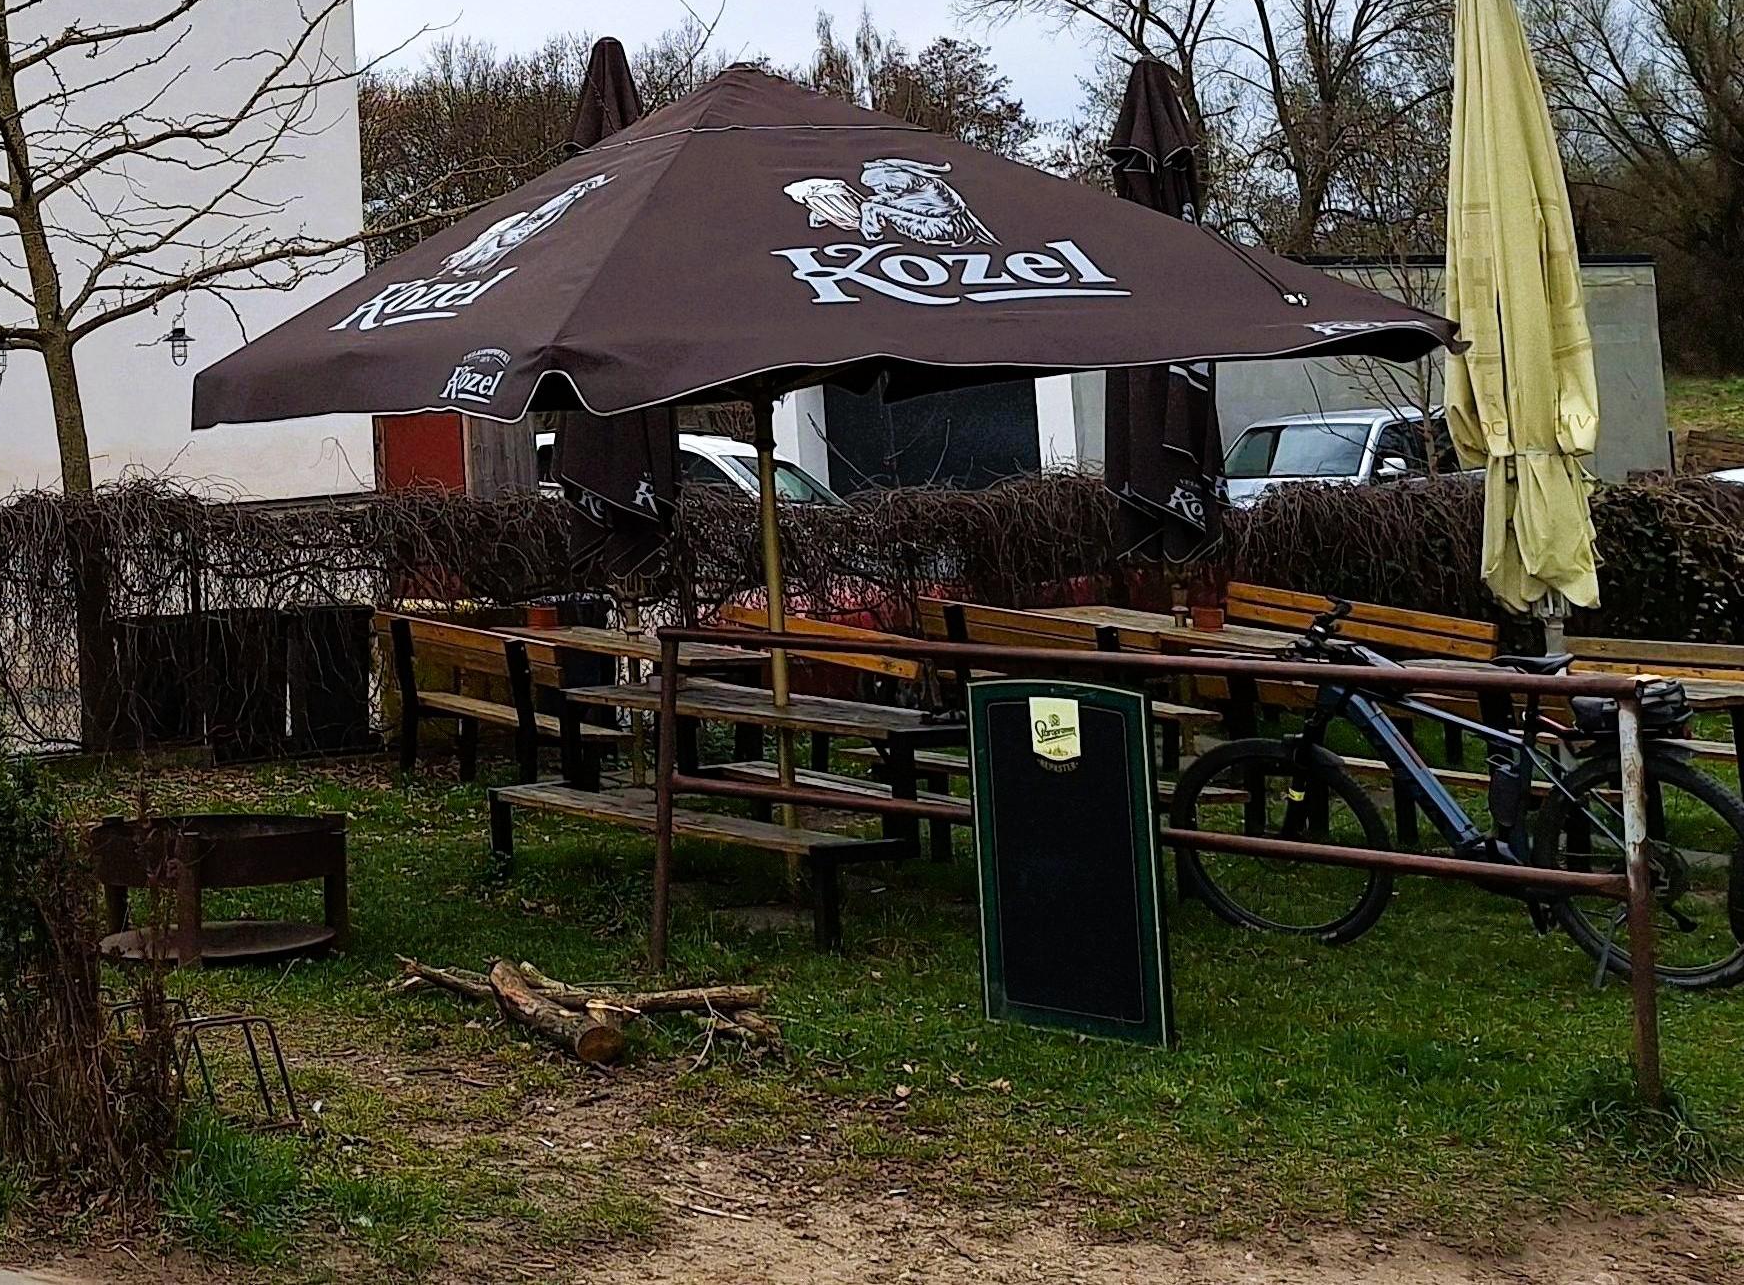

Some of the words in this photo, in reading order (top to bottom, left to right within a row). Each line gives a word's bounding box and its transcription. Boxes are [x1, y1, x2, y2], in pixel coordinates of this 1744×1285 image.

[328, 266, 520, 331] Kozel
[770, 240, 1132, 305] Kozel
[438, 365, 505, 403] Kozel
